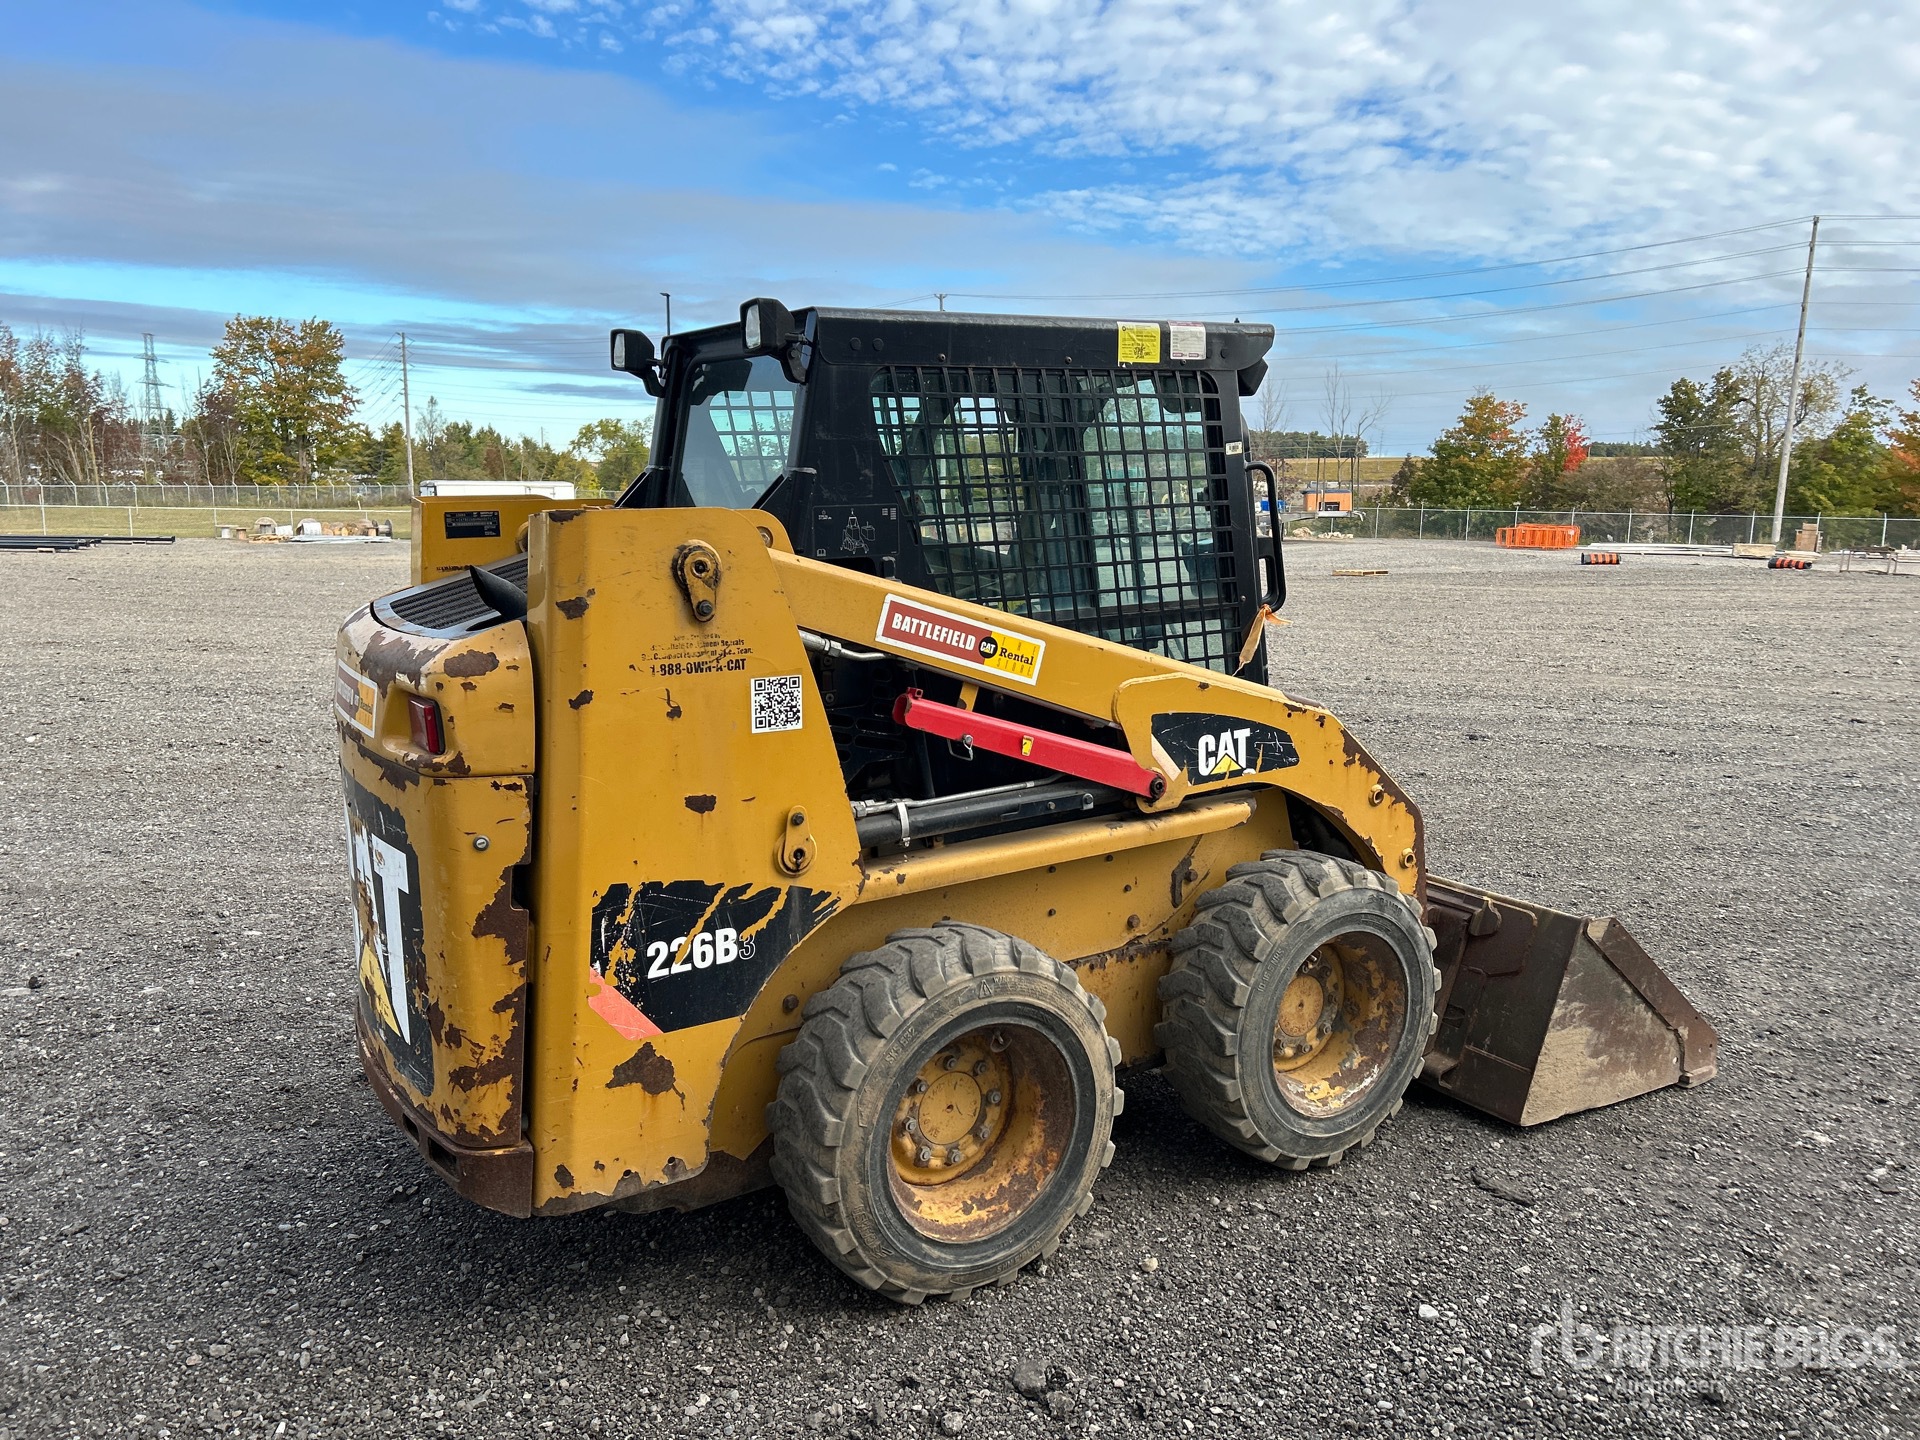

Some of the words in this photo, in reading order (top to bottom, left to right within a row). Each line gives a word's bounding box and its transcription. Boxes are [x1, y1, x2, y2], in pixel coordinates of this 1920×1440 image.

[891, 612, 976, 651] BATTLEFIELD
[980, 641, 996, 655] CAT
[999, 646, 1034, 666] Rental
[1197, 727, 1251, 776] CAT
